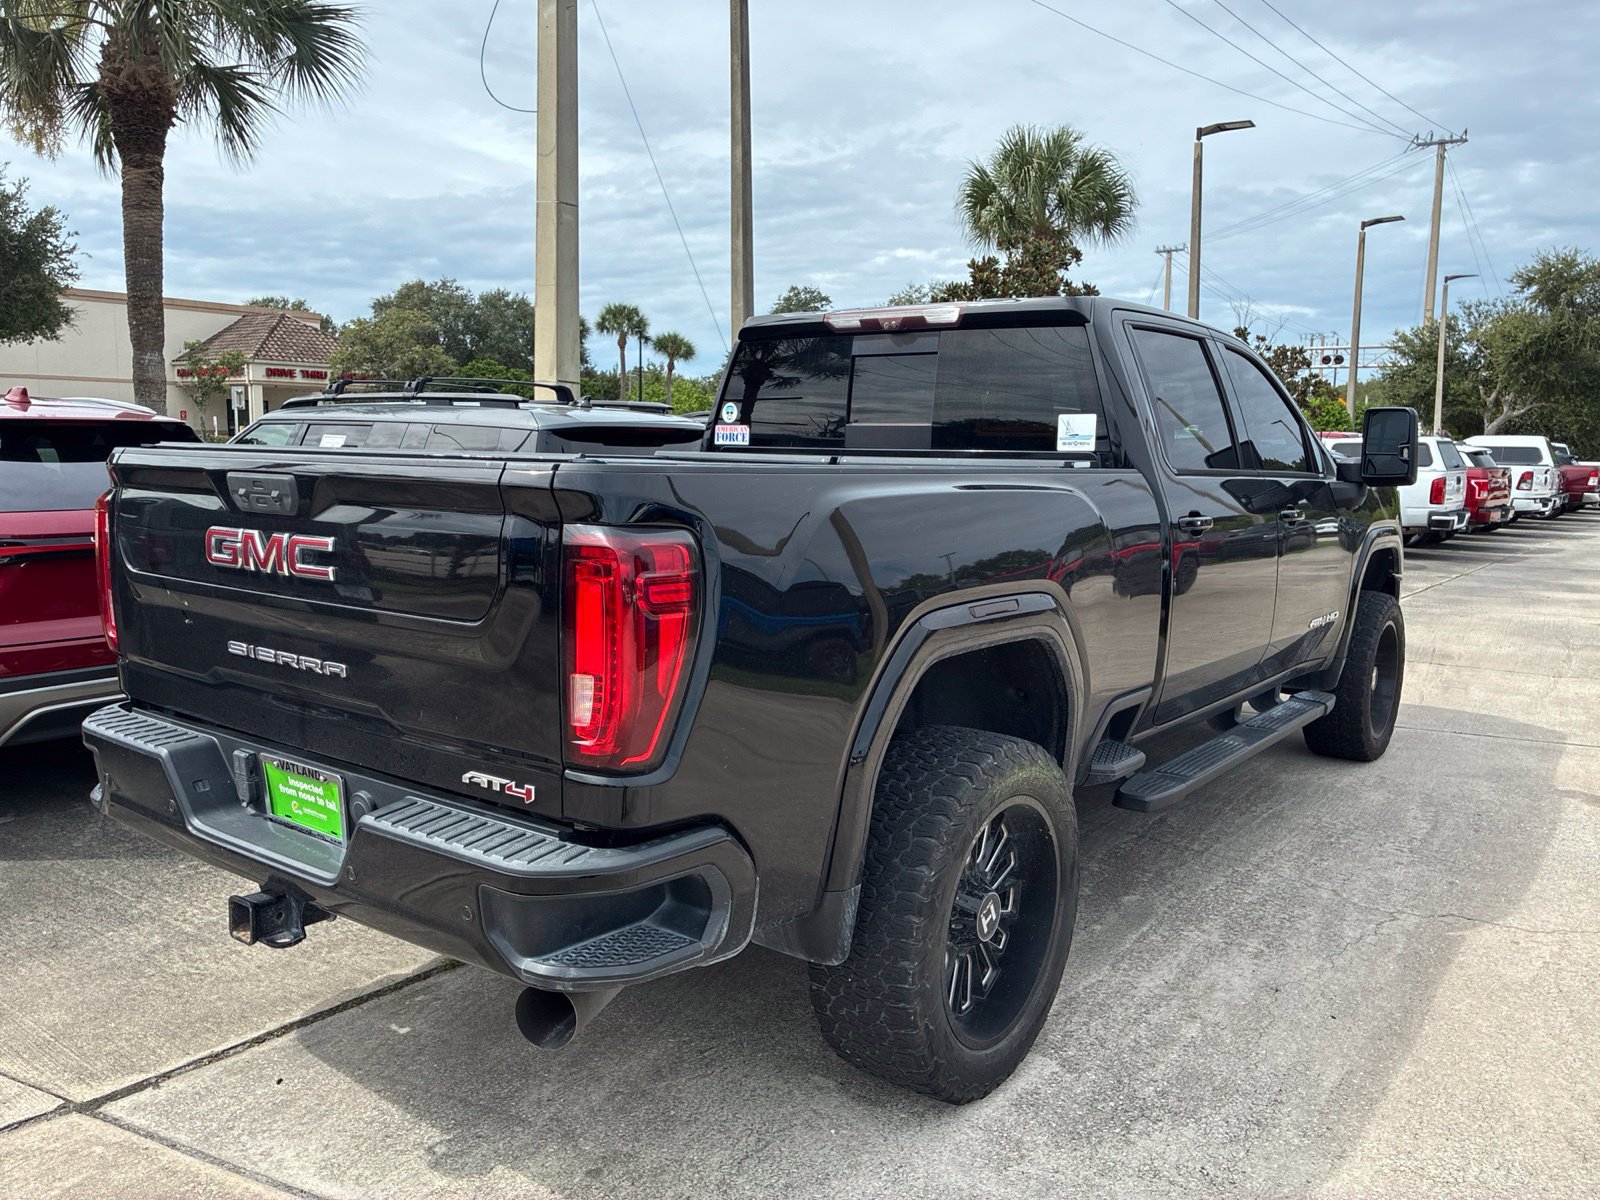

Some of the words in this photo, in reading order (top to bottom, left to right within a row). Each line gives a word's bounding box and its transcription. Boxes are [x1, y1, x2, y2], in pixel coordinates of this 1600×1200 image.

[265, 367, 296, 378] DRIVE
[301, 369, 328, 380] THRU
[716, 432, 748, 442] FORCE
[205, 525, 336, 582] GMC
[227, 640, 348, 678] SIERRA
[278, 783, 298, 797] from
[298, 791, 316, 803] nose
[316, 797, 325, 807] to
[287, 775, 324, 796] Inspected
[461, 770, 535, 804] AT4
